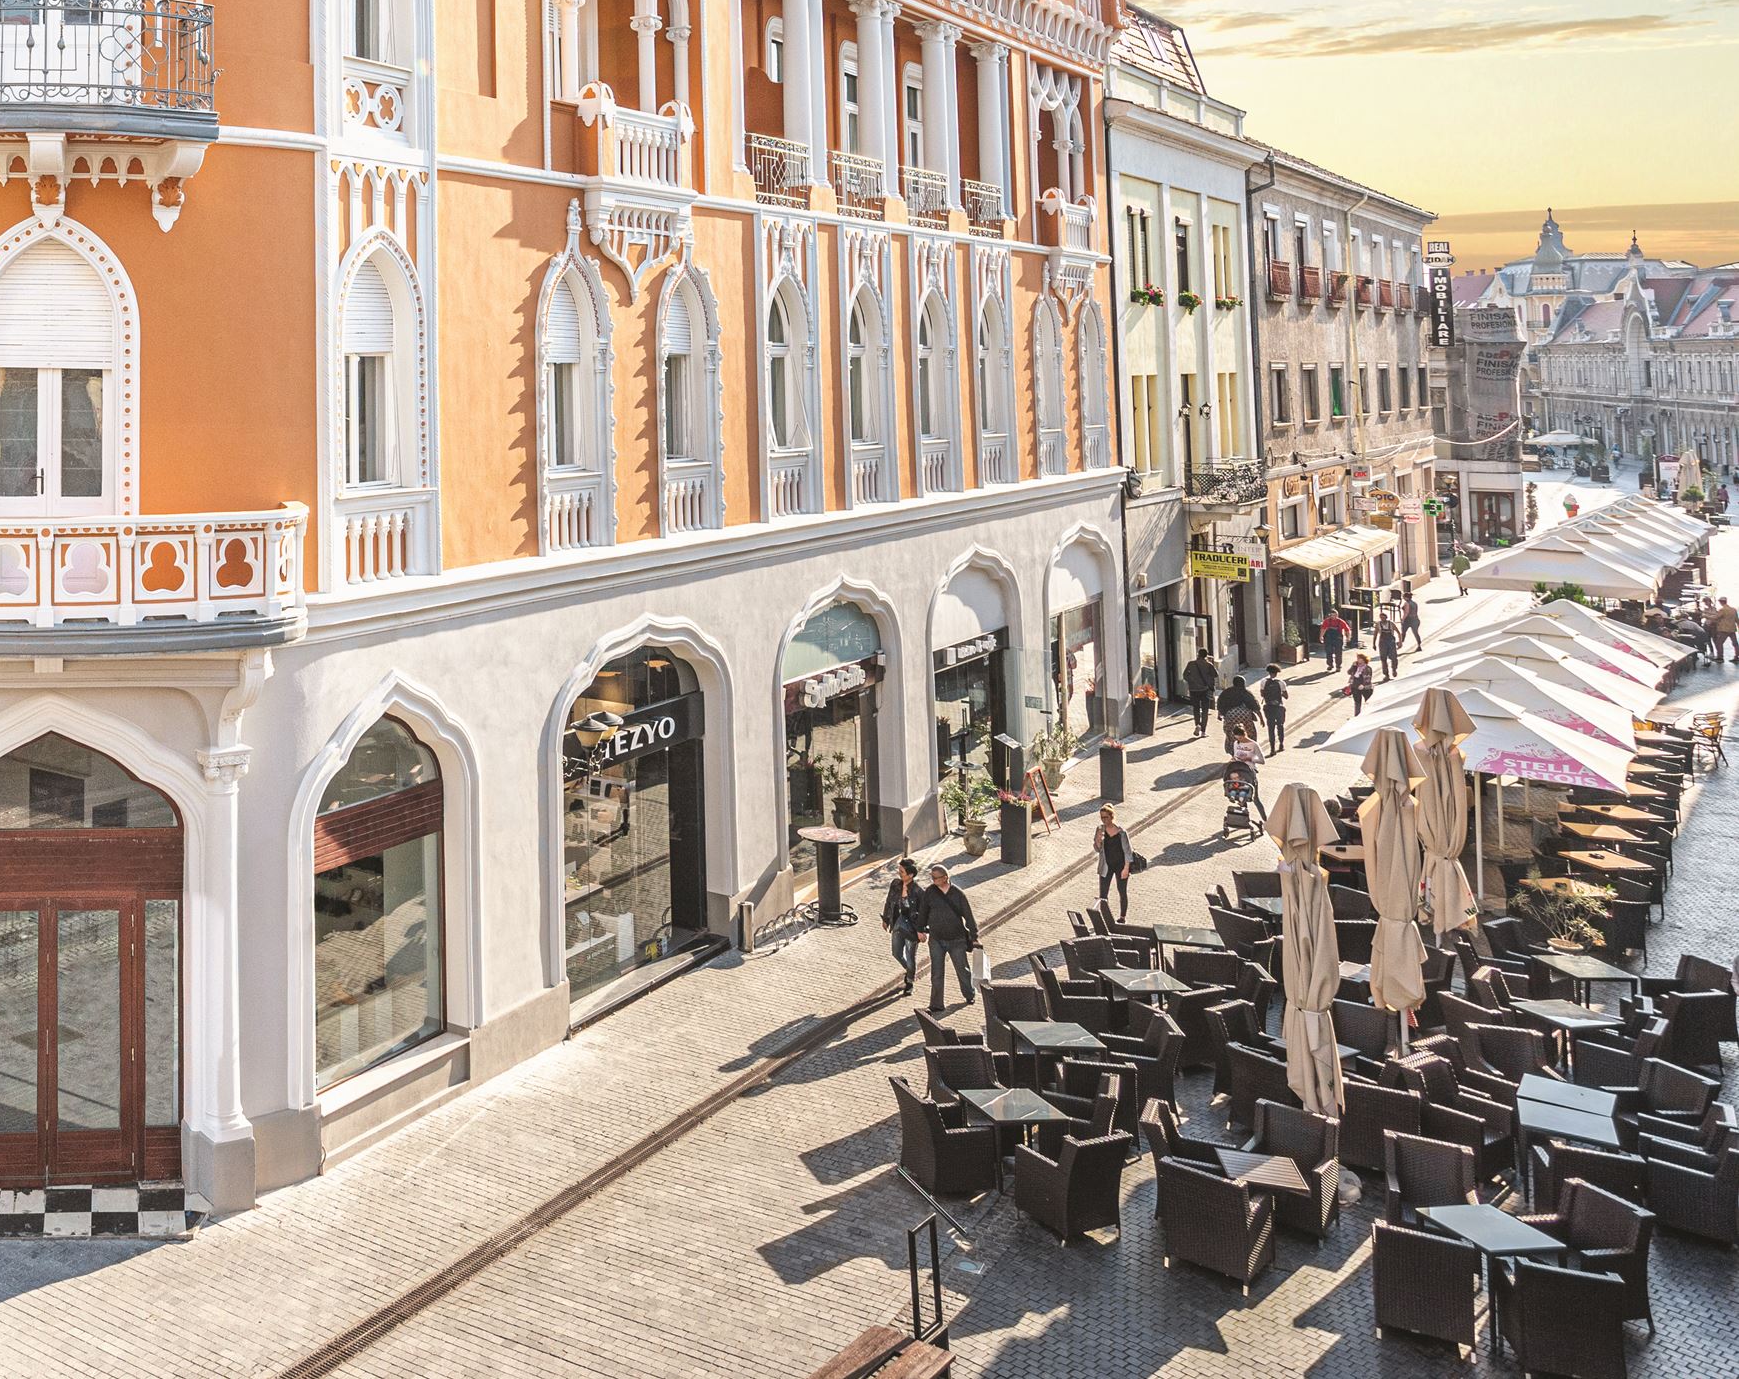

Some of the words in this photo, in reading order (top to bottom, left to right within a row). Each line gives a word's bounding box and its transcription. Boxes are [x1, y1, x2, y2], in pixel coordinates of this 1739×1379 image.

[1429, 242, 1449, 252] REAL
[1433, 269, 1450, 345] IMOBILIARE
[1194, 552, 1247, 565] TRADUCERI
[1503, 758, 1596, 776] STELLA
[1503, 768, 1599, 787] ARTOIS
